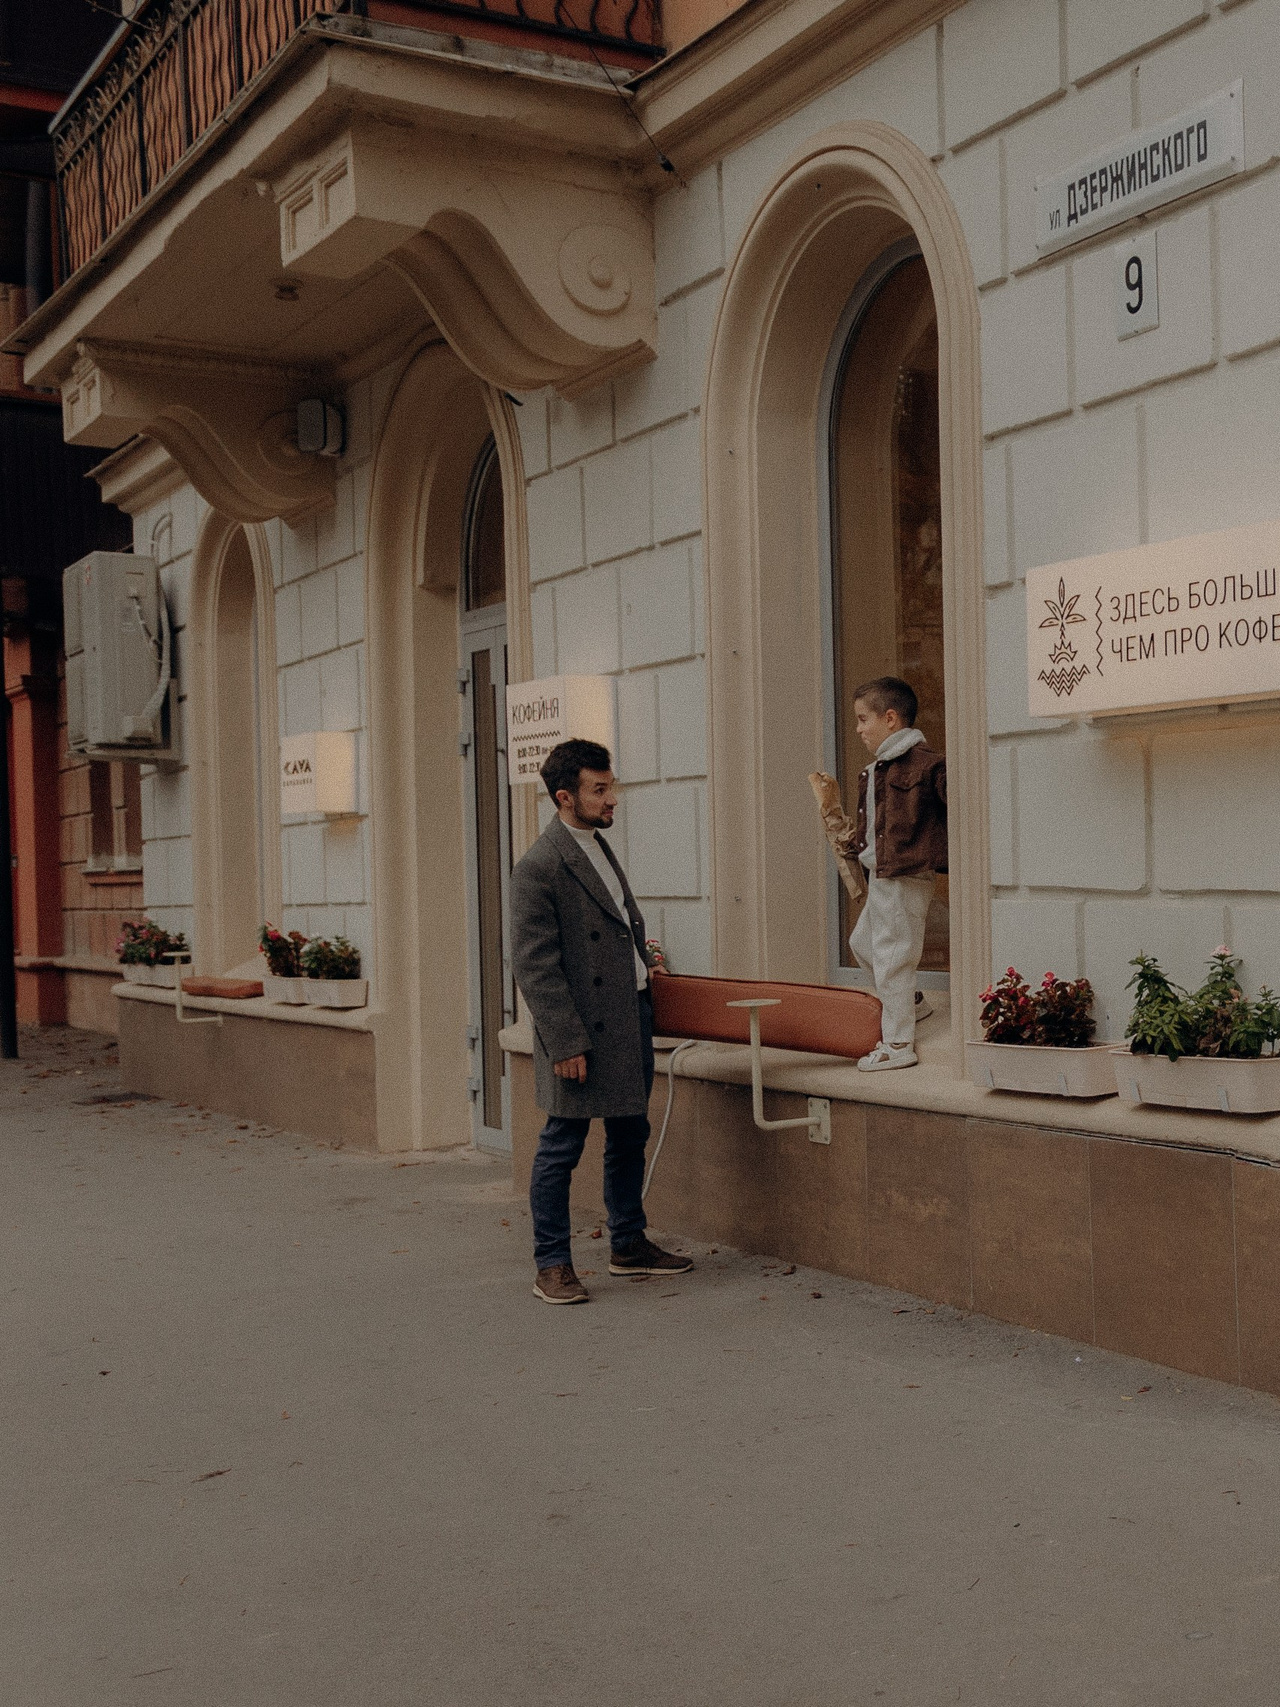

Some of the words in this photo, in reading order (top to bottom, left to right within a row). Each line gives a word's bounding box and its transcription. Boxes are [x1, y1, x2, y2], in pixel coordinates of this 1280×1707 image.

[1049, 208, 1061, 231] ул
[1066, 119, 1208, 228] ДЗЕРЖИНСКОГО
[1124, 255, 1144, 315] 9
[1109, 586, 1180, 625] ЗДЕСЬ
[1110, 632, 1156, 663] ЧЕМ
[1164, 624, 1210, 657] ПРО
[511, 696, 560, 725] КОФЕЙНЯ
